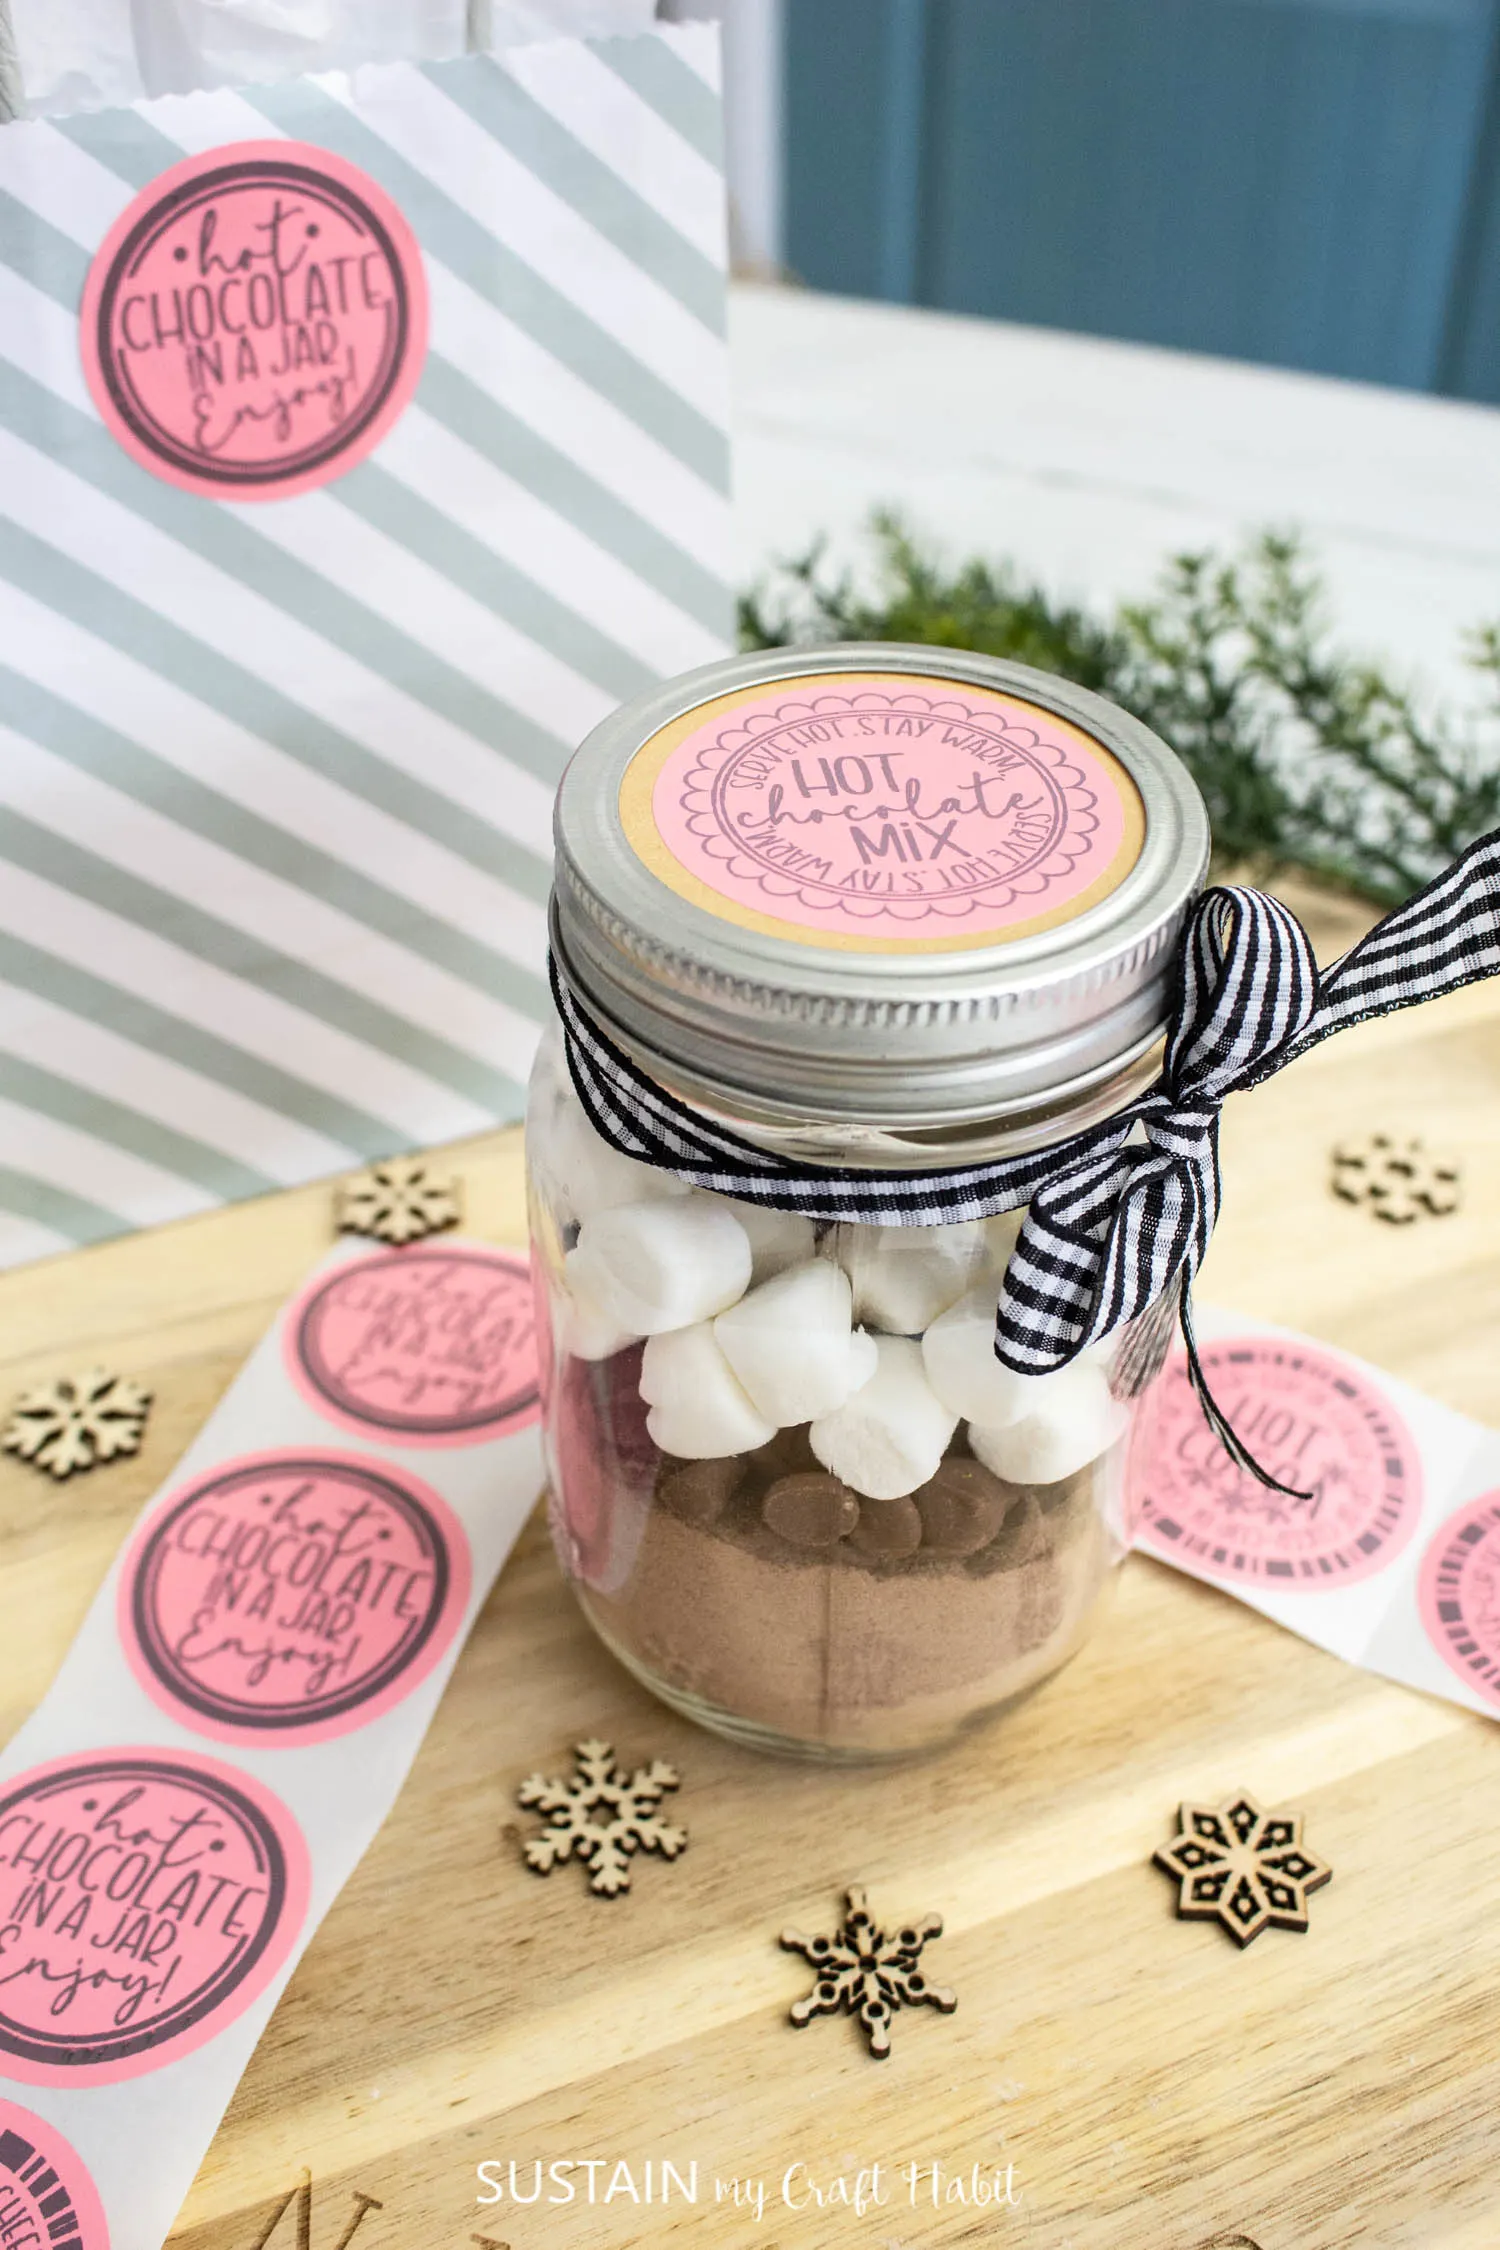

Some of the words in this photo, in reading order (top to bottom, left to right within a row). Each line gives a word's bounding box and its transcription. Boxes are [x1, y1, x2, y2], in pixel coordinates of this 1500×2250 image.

[199, 200, 308, 277] hot
[121, 251, 387, 352] CHOCOLATE
[237, 335, 259, 382] A
[270, 321, 338, 376] JAR
[193, 345, 359, 452] Enjoy!
[729, 739, 797, 790] SERVE
[857, 717, 935, 738] STAY
[791, 753, 905, 798] HOT
[737, 771, 1044, 828] chocolate
[986, 812, 1052, 867] SERVE
[839, 869, 924, 892] STAY
[1177, 1424, 1326, 1519] COOA
[272, 1480, 388, 1556] hot
[176, 1509, 434, 1620] CHOCOLATE
[246, 1579, 277, 1622] A
[277, 1590, 355, 1645] JAR
[176, 1607, 362, 1695] Enjoy!
[94, 1786, 223, 1867] hot
[0, 1814, 267, 1938] CHOCOLATE
[9, 1877, 66, 1928] IN
[55, 1894, 93, 1940] A
[90, 1906, 178, 1967] JAR
